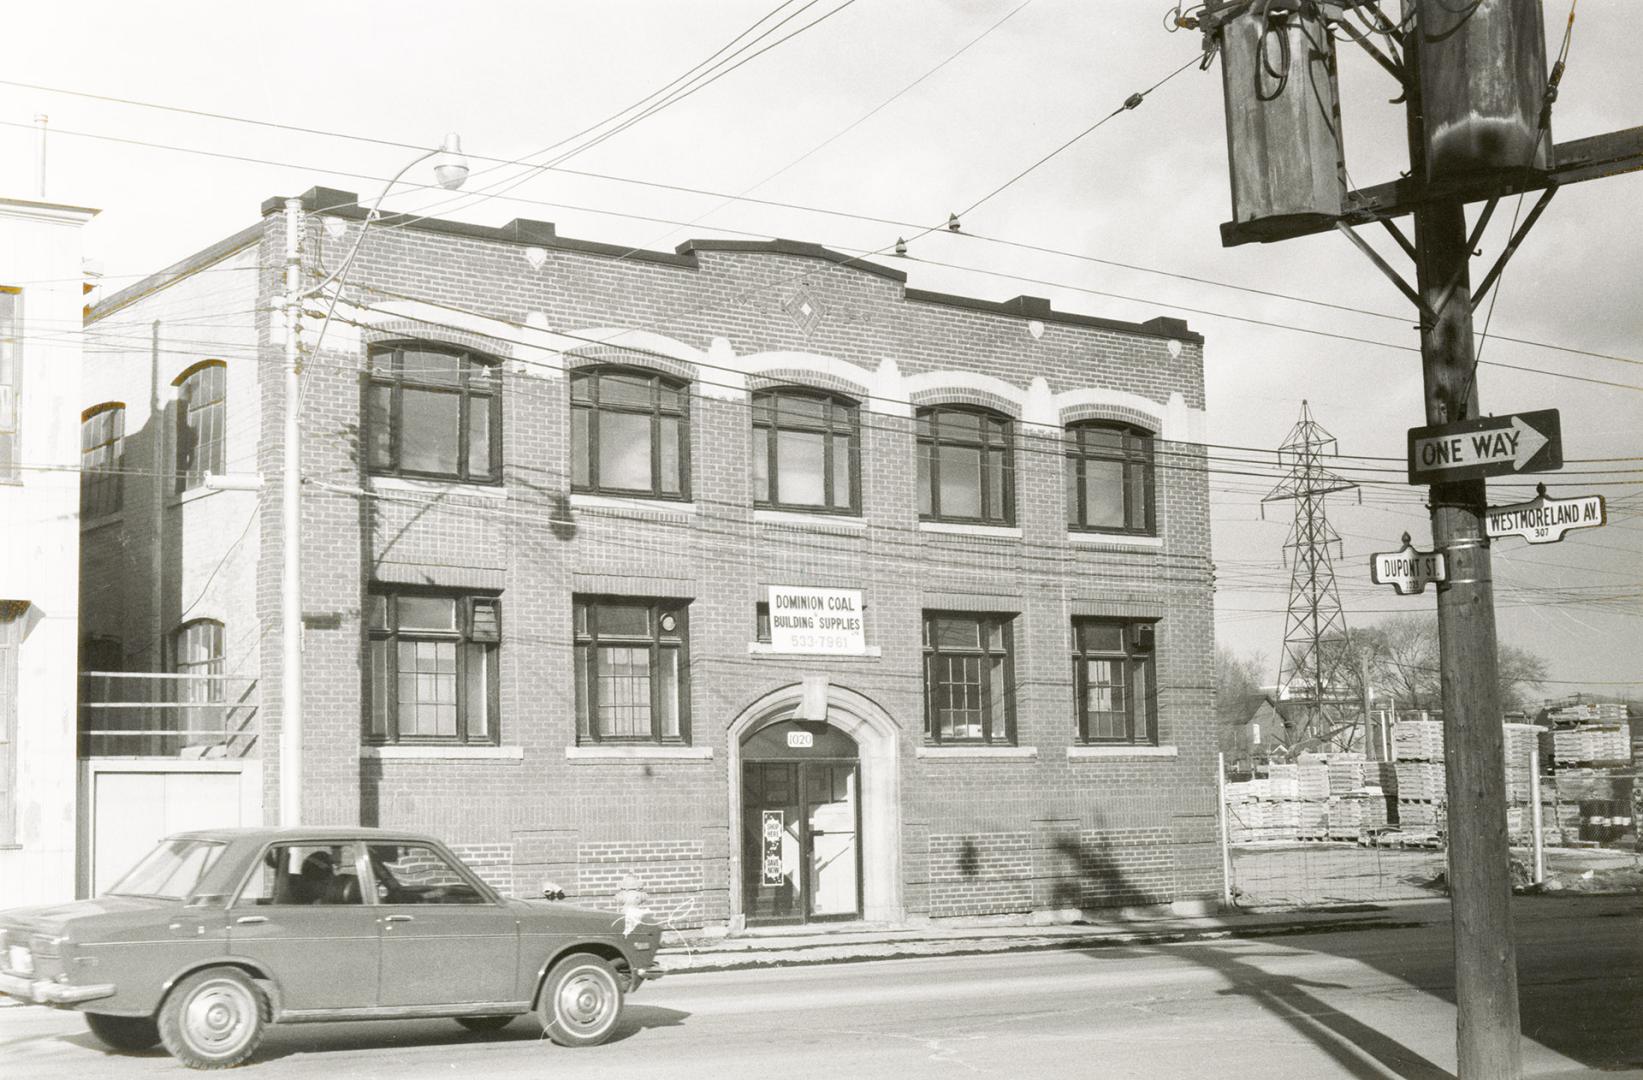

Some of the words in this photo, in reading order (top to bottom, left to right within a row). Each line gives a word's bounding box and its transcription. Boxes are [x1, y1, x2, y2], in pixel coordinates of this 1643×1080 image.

[1422, 438, 1463, 466] ONE
[1472, 430, 1521, 459] WAY
[1489, 504, 1580, 532] WESTMORELAND
[1583, 502, 1599, 522] AV.
[1535, 528, 1549, 538] 307
[1384, 559, 1420, 577] DUPONT
[1426, 558, 1440, 577] ST.
[776, 594, 825, 611] DOMINION
[828, 596, 855, 611] COAL
[773, 615, 814, 629] BUILDING
[819, 617, 860, 630] SUPPLIES
[791, 635, 848, 649] 533-7961
[790, 734, 812, 745] 1020
